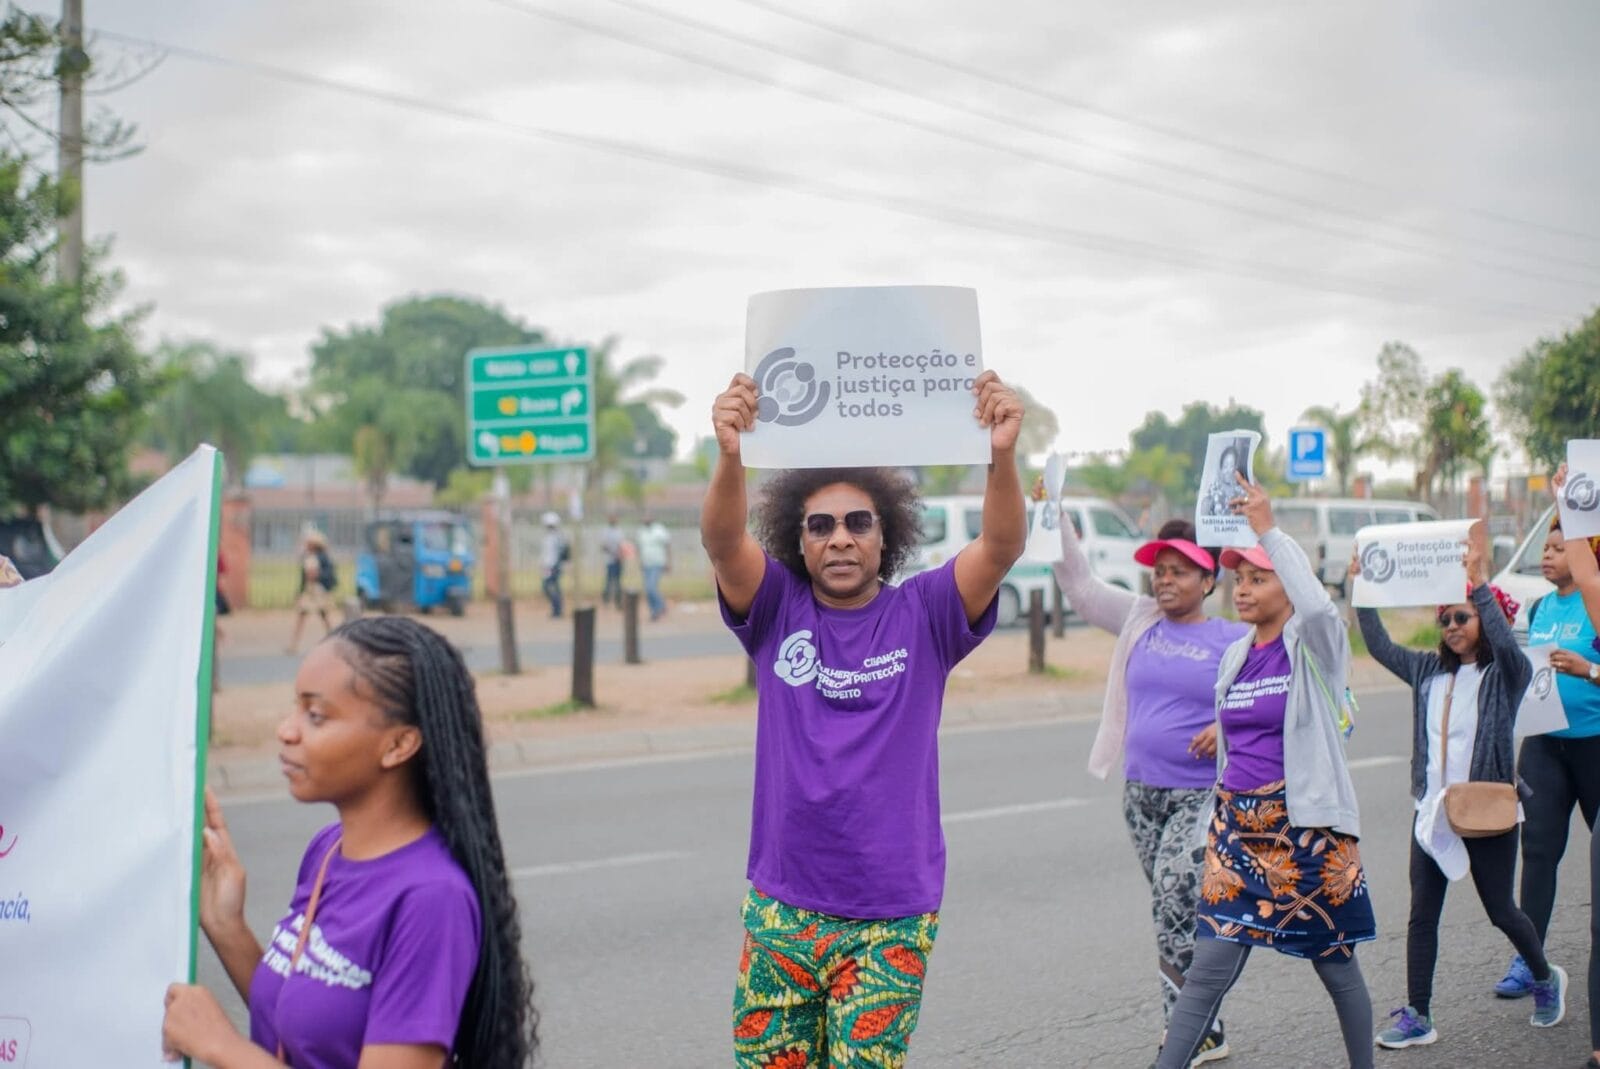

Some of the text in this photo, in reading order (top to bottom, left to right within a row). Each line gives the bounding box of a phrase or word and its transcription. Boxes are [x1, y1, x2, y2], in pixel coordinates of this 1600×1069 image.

[837, 349, 976, 373] Protecção e
[835, 375, 916, 399] justiça
[837, 399, 903, 417] todos
[1397, 541, 1452, 552] Protecção
[1397, 556, 1433, 569] justiça
[1400, 568, 1429, 578] todos
